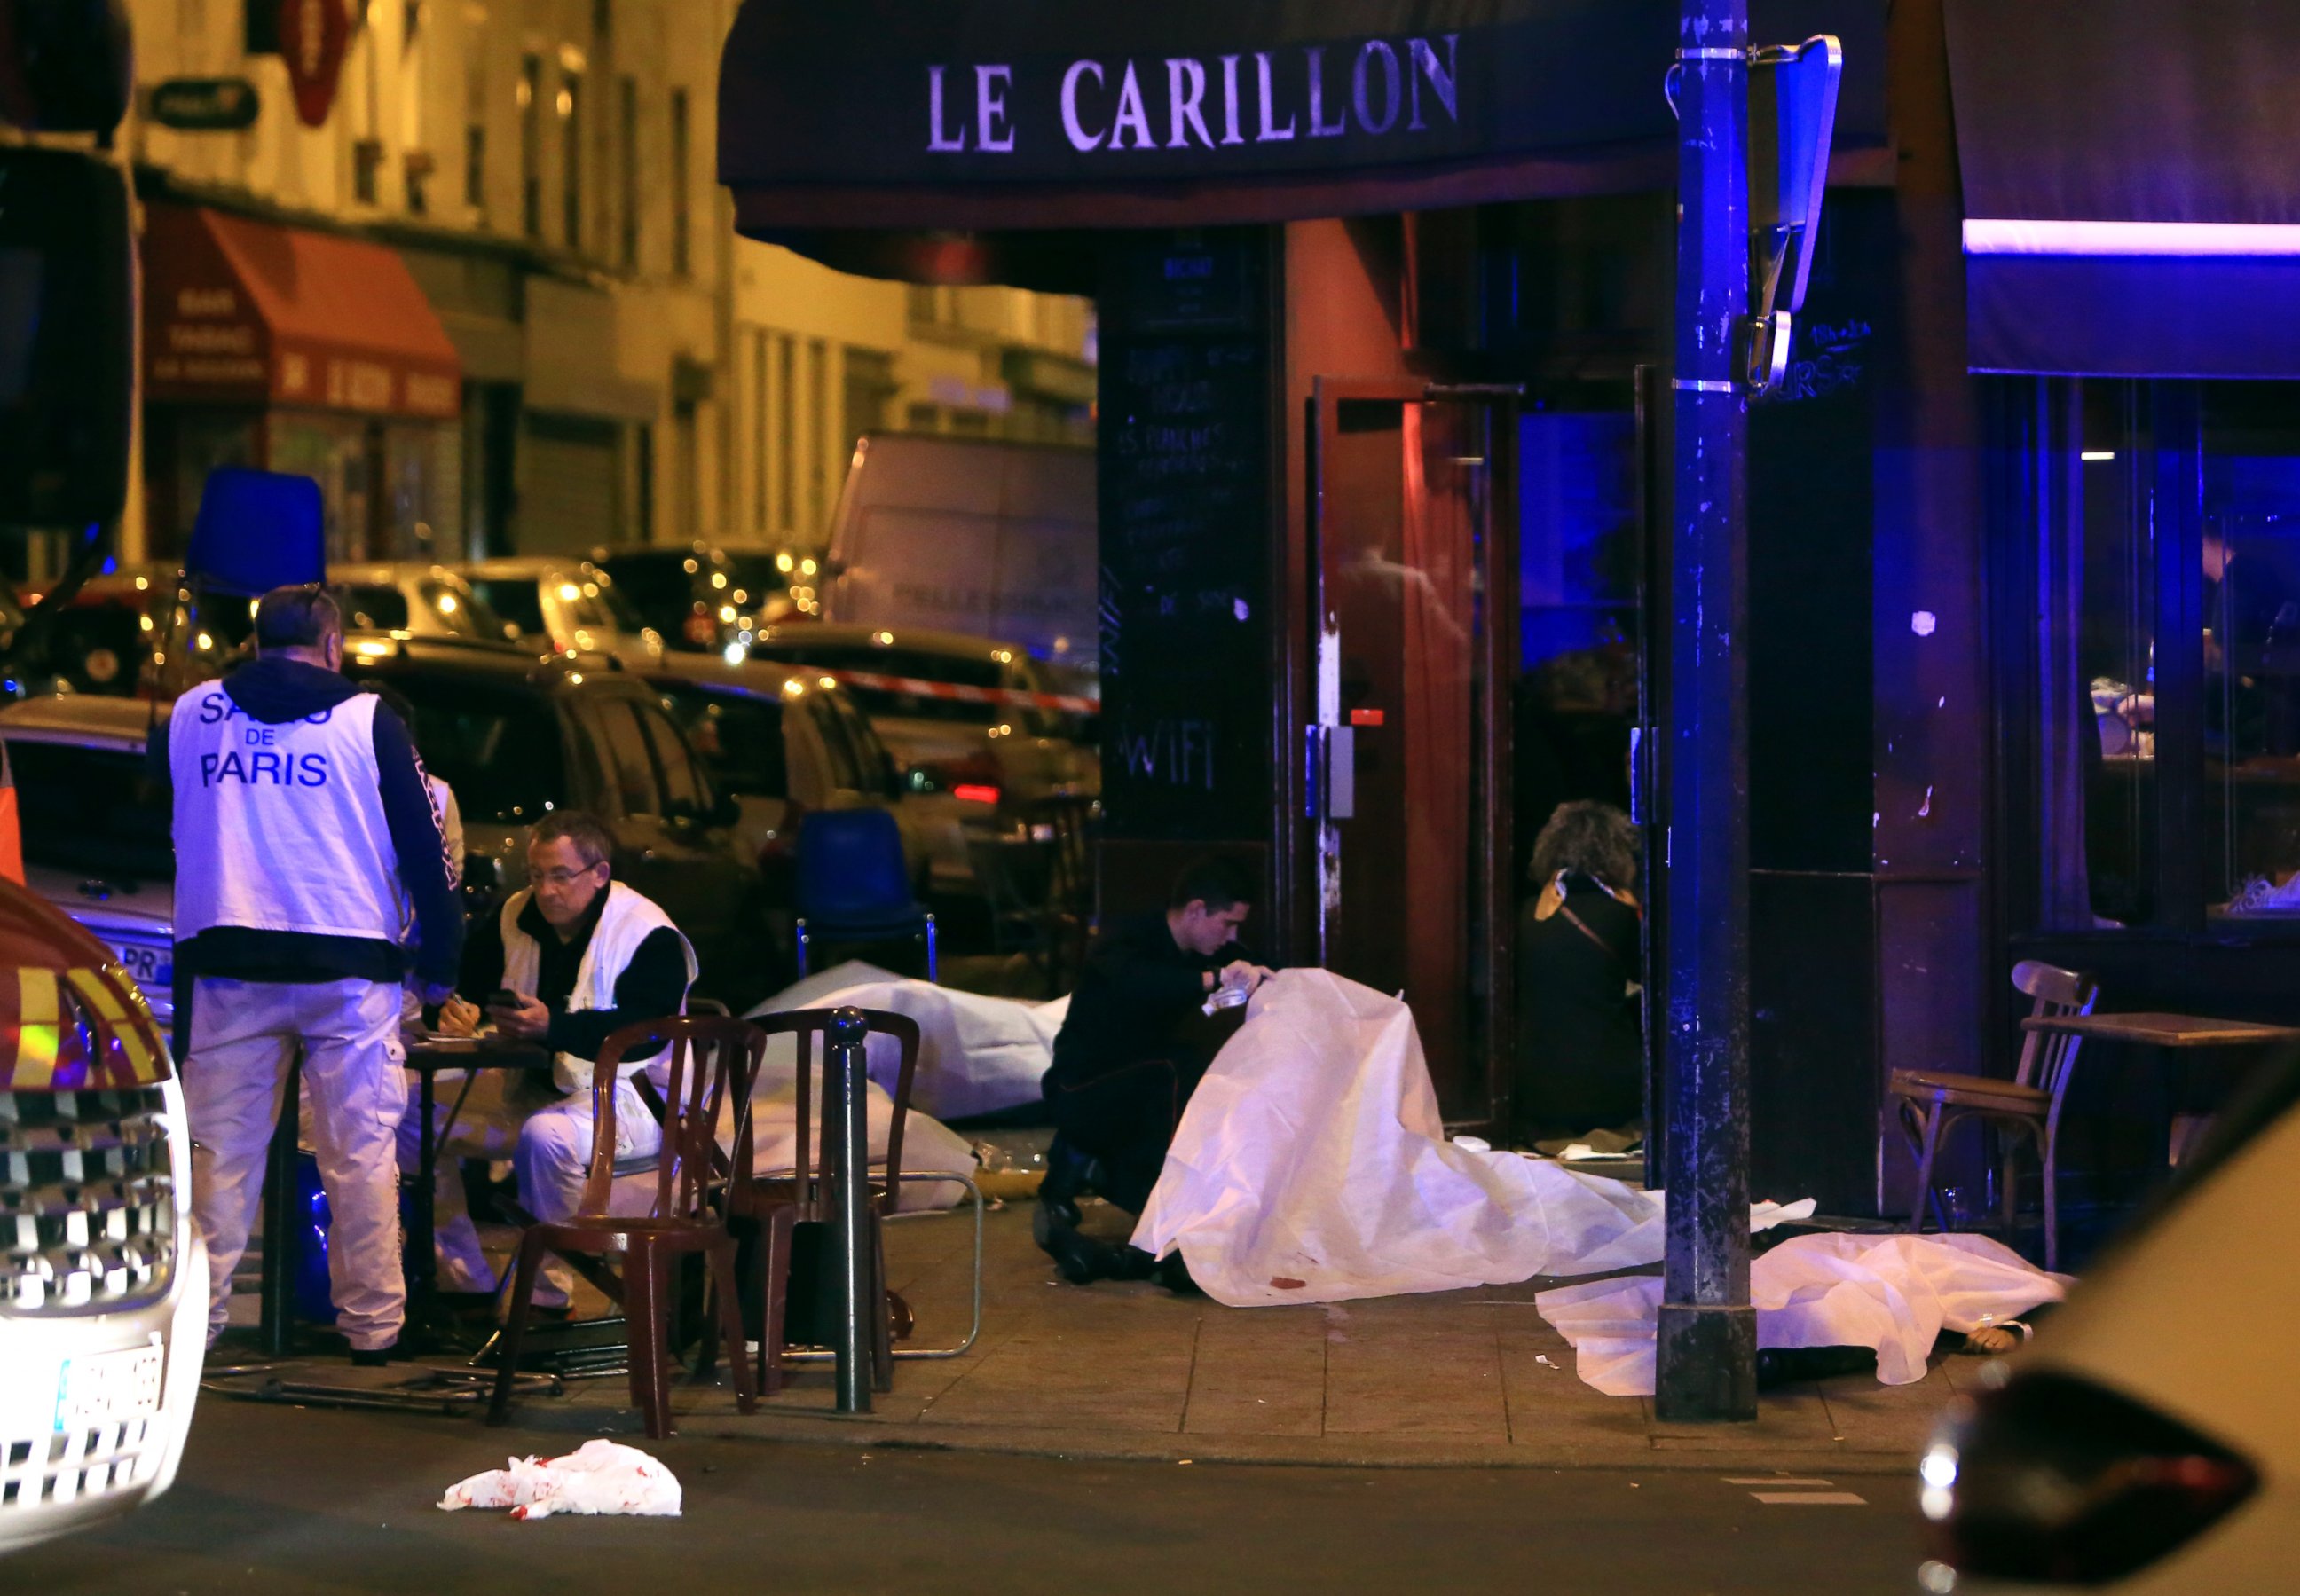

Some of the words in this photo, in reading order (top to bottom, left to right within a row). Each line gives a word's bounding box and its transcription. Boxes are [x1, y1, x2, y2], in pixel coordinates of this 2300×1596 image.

[926, 64, 1015, 153] LE
[1060, 34, 1460, 153] CARILLON
[245, 728, 275, 746] DE
[1121, 719, 1215, 791] WIFI
[200, 751, 327, 788] PARIS
